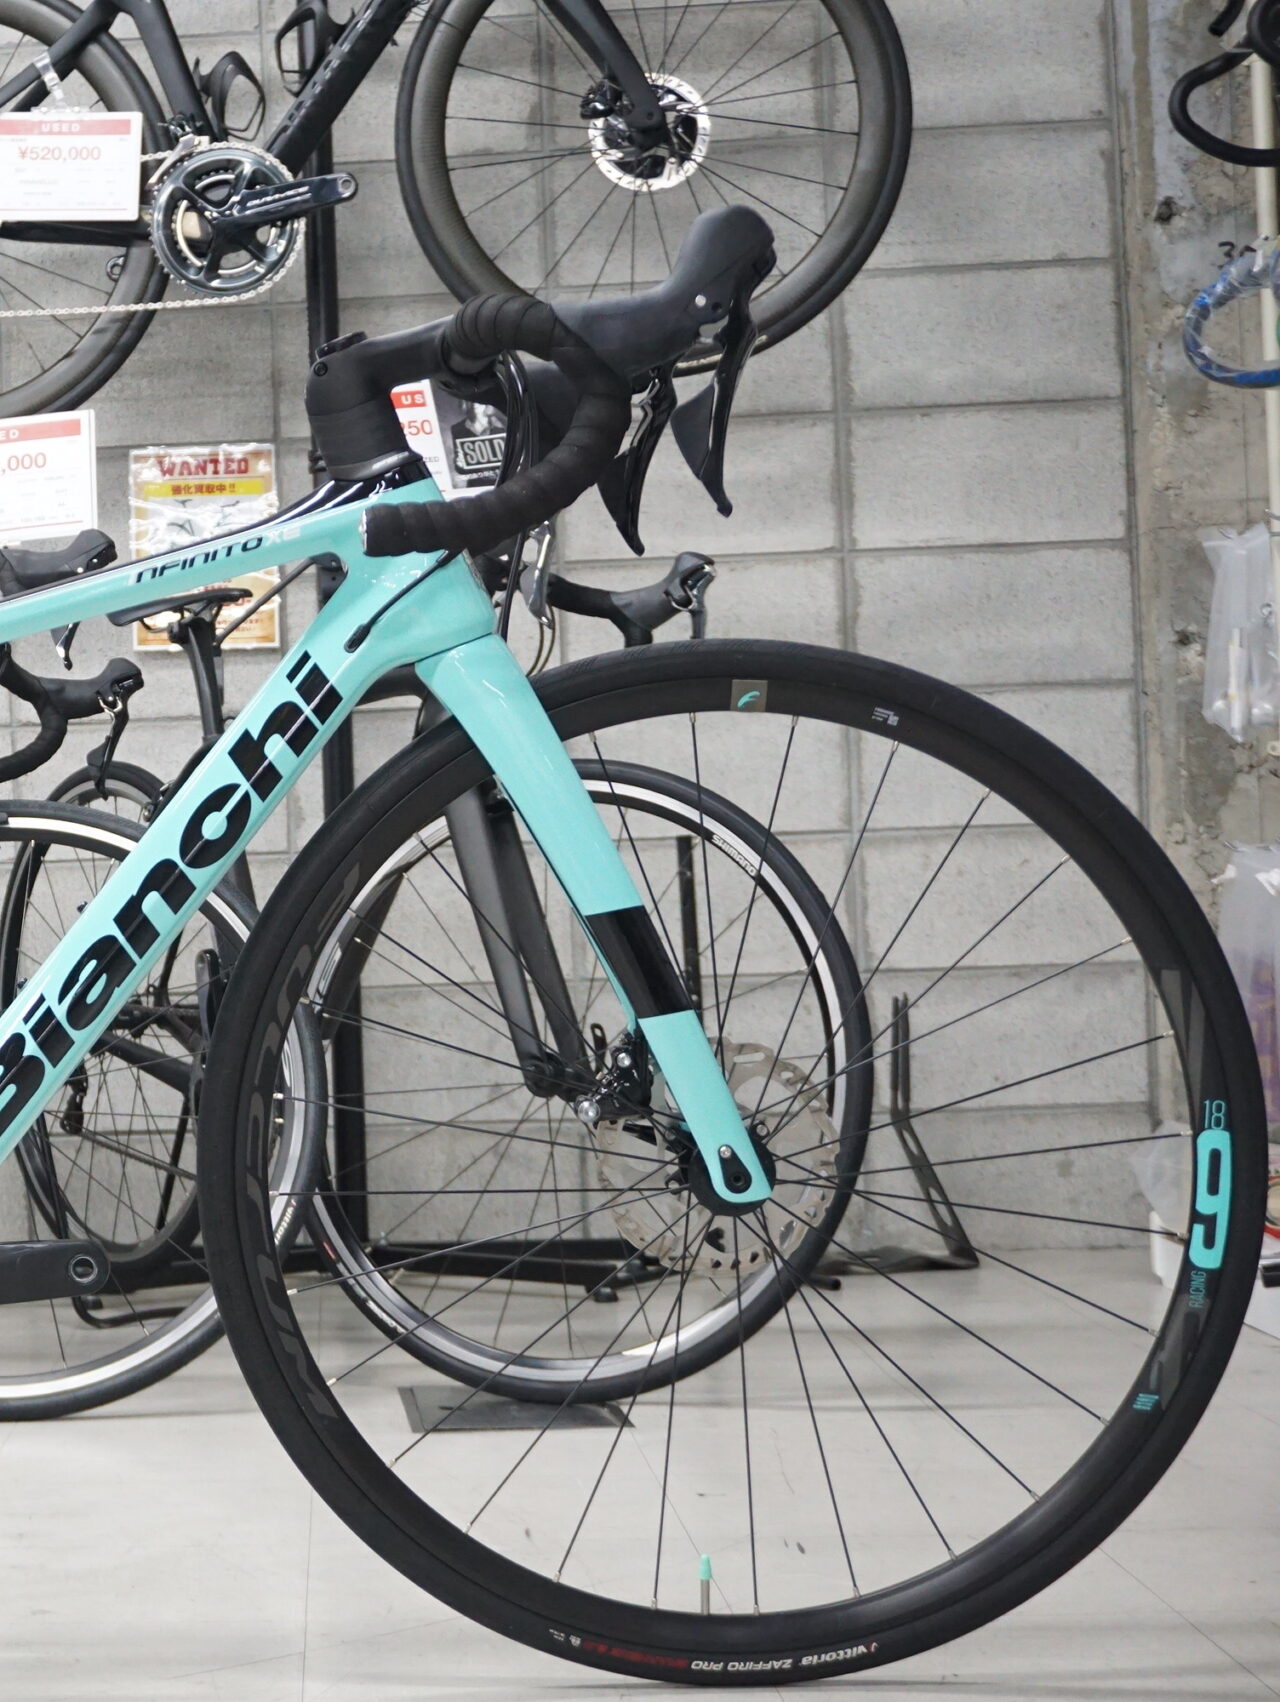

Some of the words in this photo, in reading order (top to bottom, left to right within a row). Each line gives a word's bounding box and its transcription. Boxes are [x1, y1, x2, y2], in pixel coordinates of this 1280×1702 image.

[41, 123, 81, 133] USED
[18, 146, 102, 162] ¥520,000
[401, 394, 424, 405] US
[156, 457, 250, 476] WANTED
[1188, 1270, 1207, 1309] RACING
[1203, 1099, 1227, 1130] 18
[691, 1659, 723, 1672] PRO
[726, 1658, 792, 1671] ZAFFIRO
